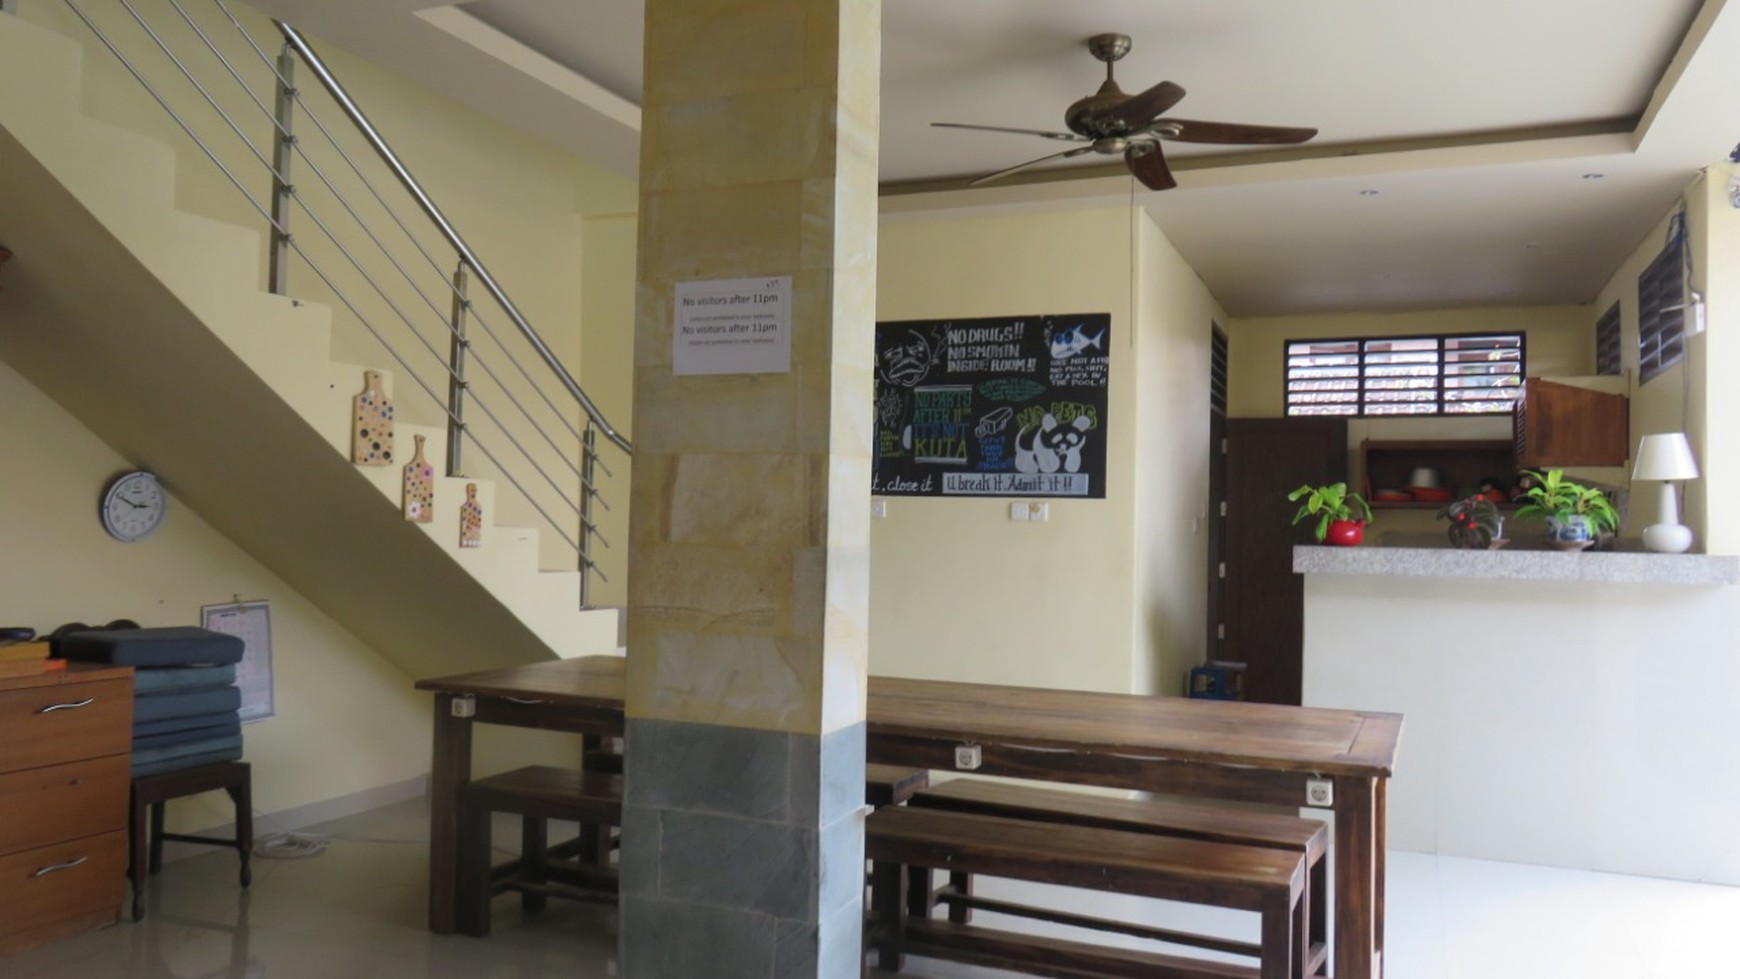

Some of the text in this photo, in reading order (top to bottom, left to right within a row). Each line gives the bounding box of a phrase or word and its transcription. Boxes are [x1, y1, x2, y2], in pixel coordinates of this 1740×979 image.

[683, 293, 778, 306] No visitors after 11pm
[682, 322, 777, 335] No visitors after 11pm
[947, 328, 967, 345] NO
[947, 343, 1020, 360] NO SMOKIN
[947, 359, 988, 373] INSIDE
[913, 407, 950, 423] AFTER
[914, 437, 968, 458] KUTA
[886, 474, 918, 492] close
[920, 474, 933, 492] it
[958, 473, 990, 491] break
